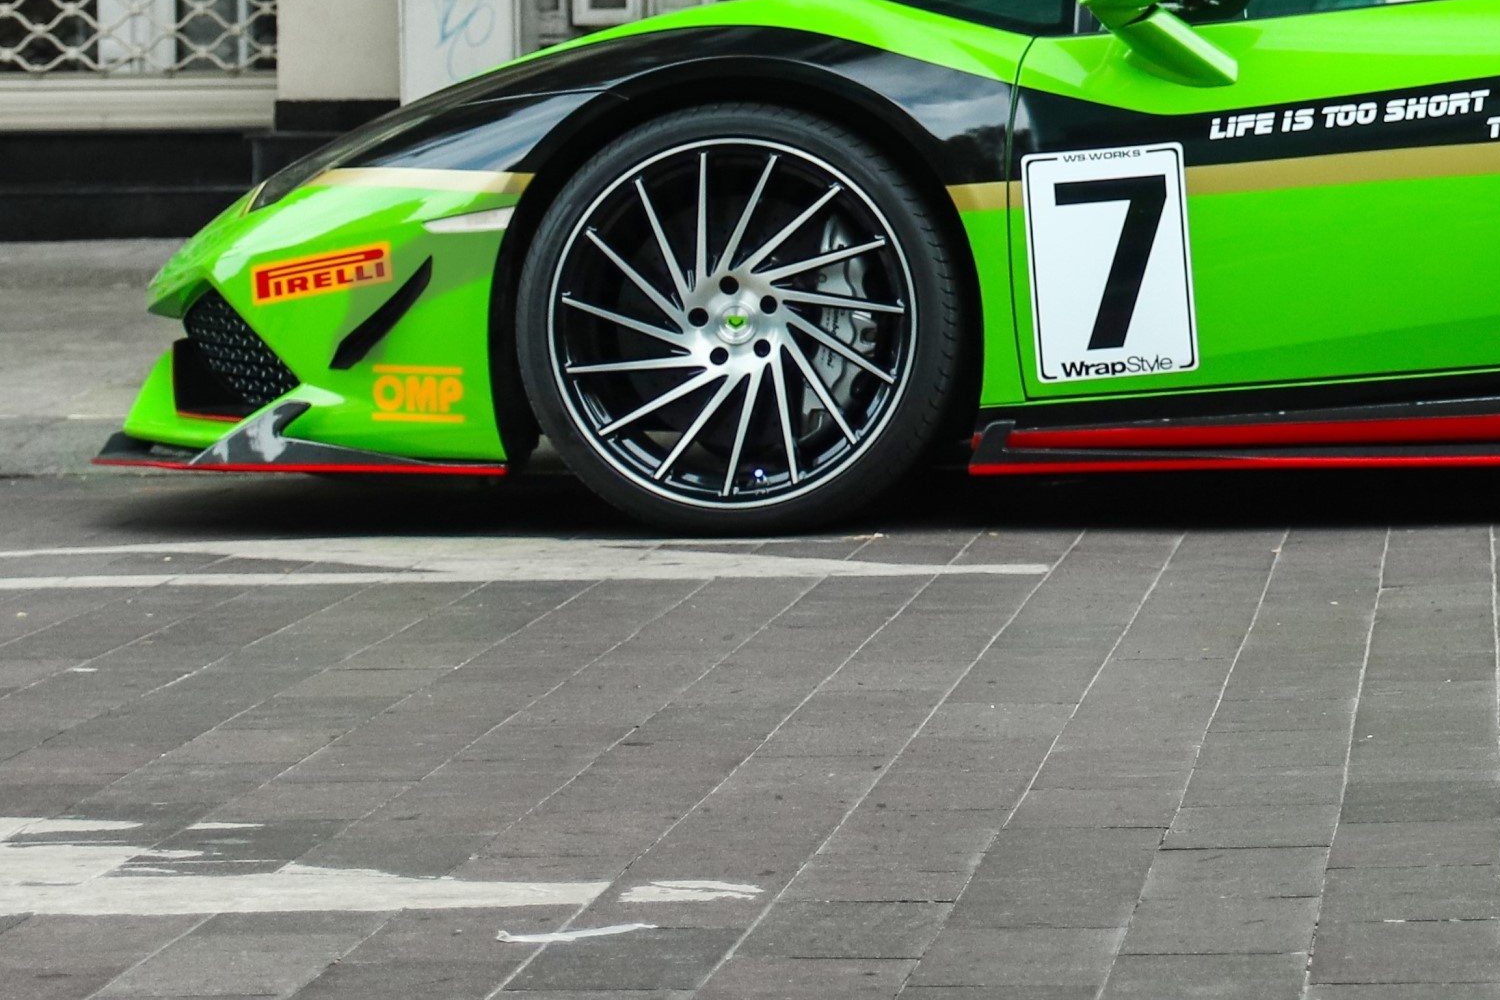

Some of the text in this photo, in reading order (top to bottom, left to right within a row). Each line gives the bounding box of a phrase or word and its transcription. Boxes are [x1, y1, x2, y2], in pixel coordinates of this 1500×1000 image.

[1209, 111, 1276, 141] LIFE
[1322, 102, 1378, 129] TOO
[1383, 89, 1491, 123] SHORT
[1063, 149, 1141, 163] WS WORKS
[255, 248, 385, 300] PIRELLI
[1053, 173, 1168, 351] 7
[1061, 355, 1174, 379] WrapStyle
[372, 374, 464, 413] OMP
